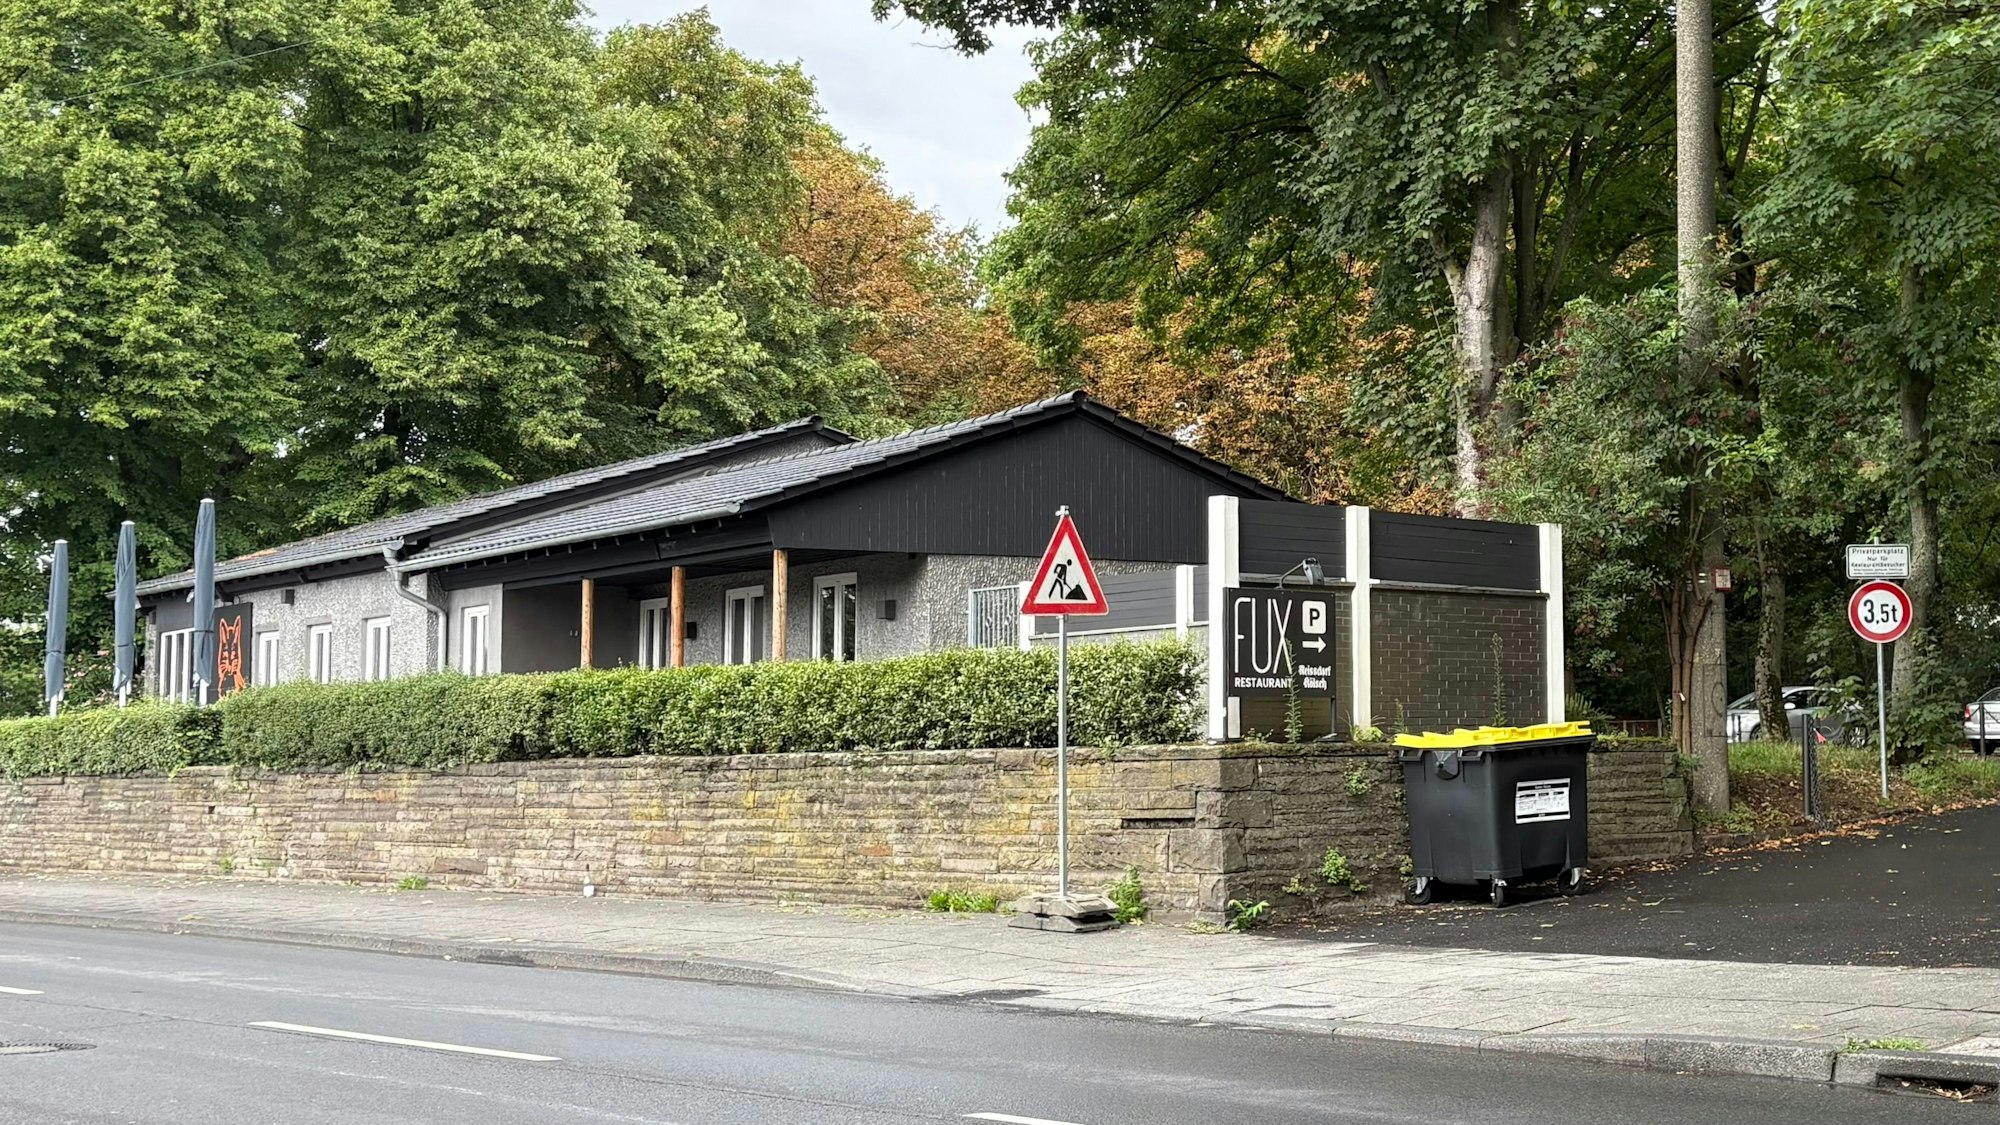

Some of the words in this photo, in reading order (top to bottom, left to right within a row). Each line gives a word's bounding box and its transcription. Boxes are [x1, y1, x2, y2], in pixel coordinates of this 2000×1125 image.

[1309, 608, 1320, 627] P
[1234, 597, 1293, 675] FUX
[1298, 664, 1331, 676] Reissdorf
[1234, 677, 1293, 688] RESTAURANT
[1303, 676, 1327, 690] Kölsch
